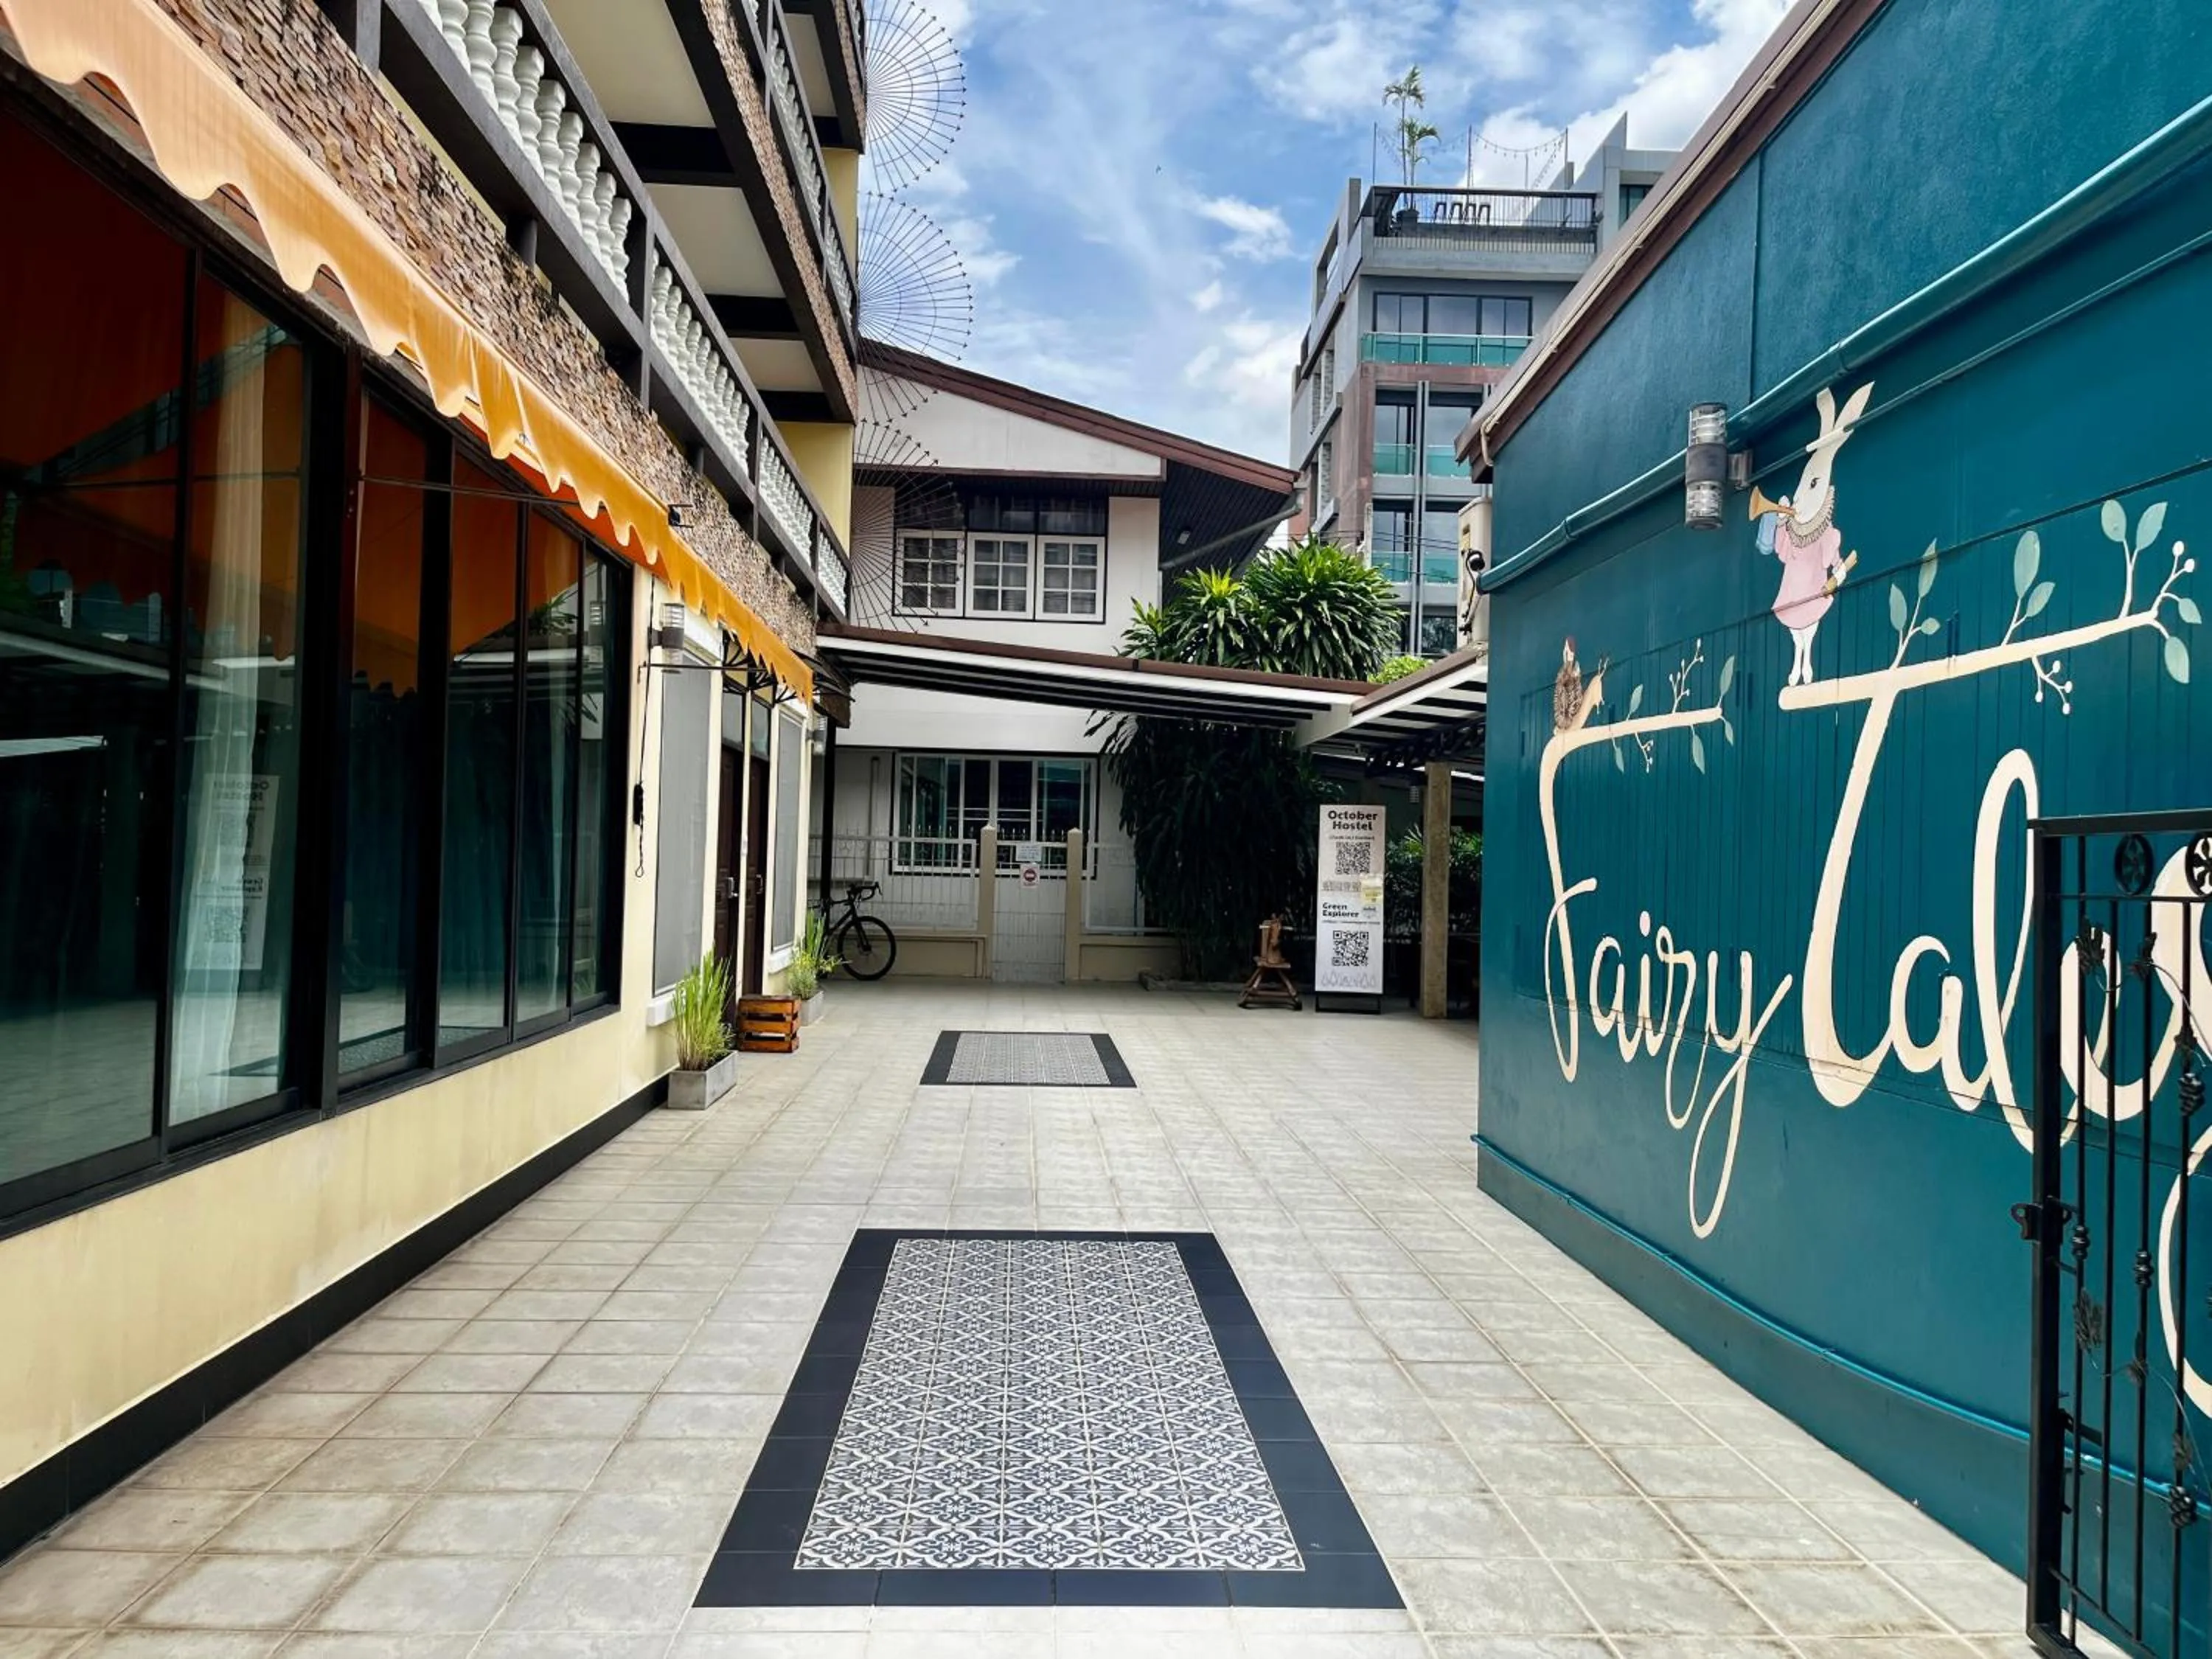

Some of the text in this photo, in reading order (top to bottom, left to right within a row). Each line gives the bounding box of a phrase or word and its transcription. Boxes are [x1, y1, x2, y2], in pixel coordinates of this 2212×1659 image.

[1328, 810, 1377, 820] October
[1332, 821, 1372, 830] Hostel
[1322, 902, 1347, 910] Green
[1539, 704, 1794, 1239] Fairy
